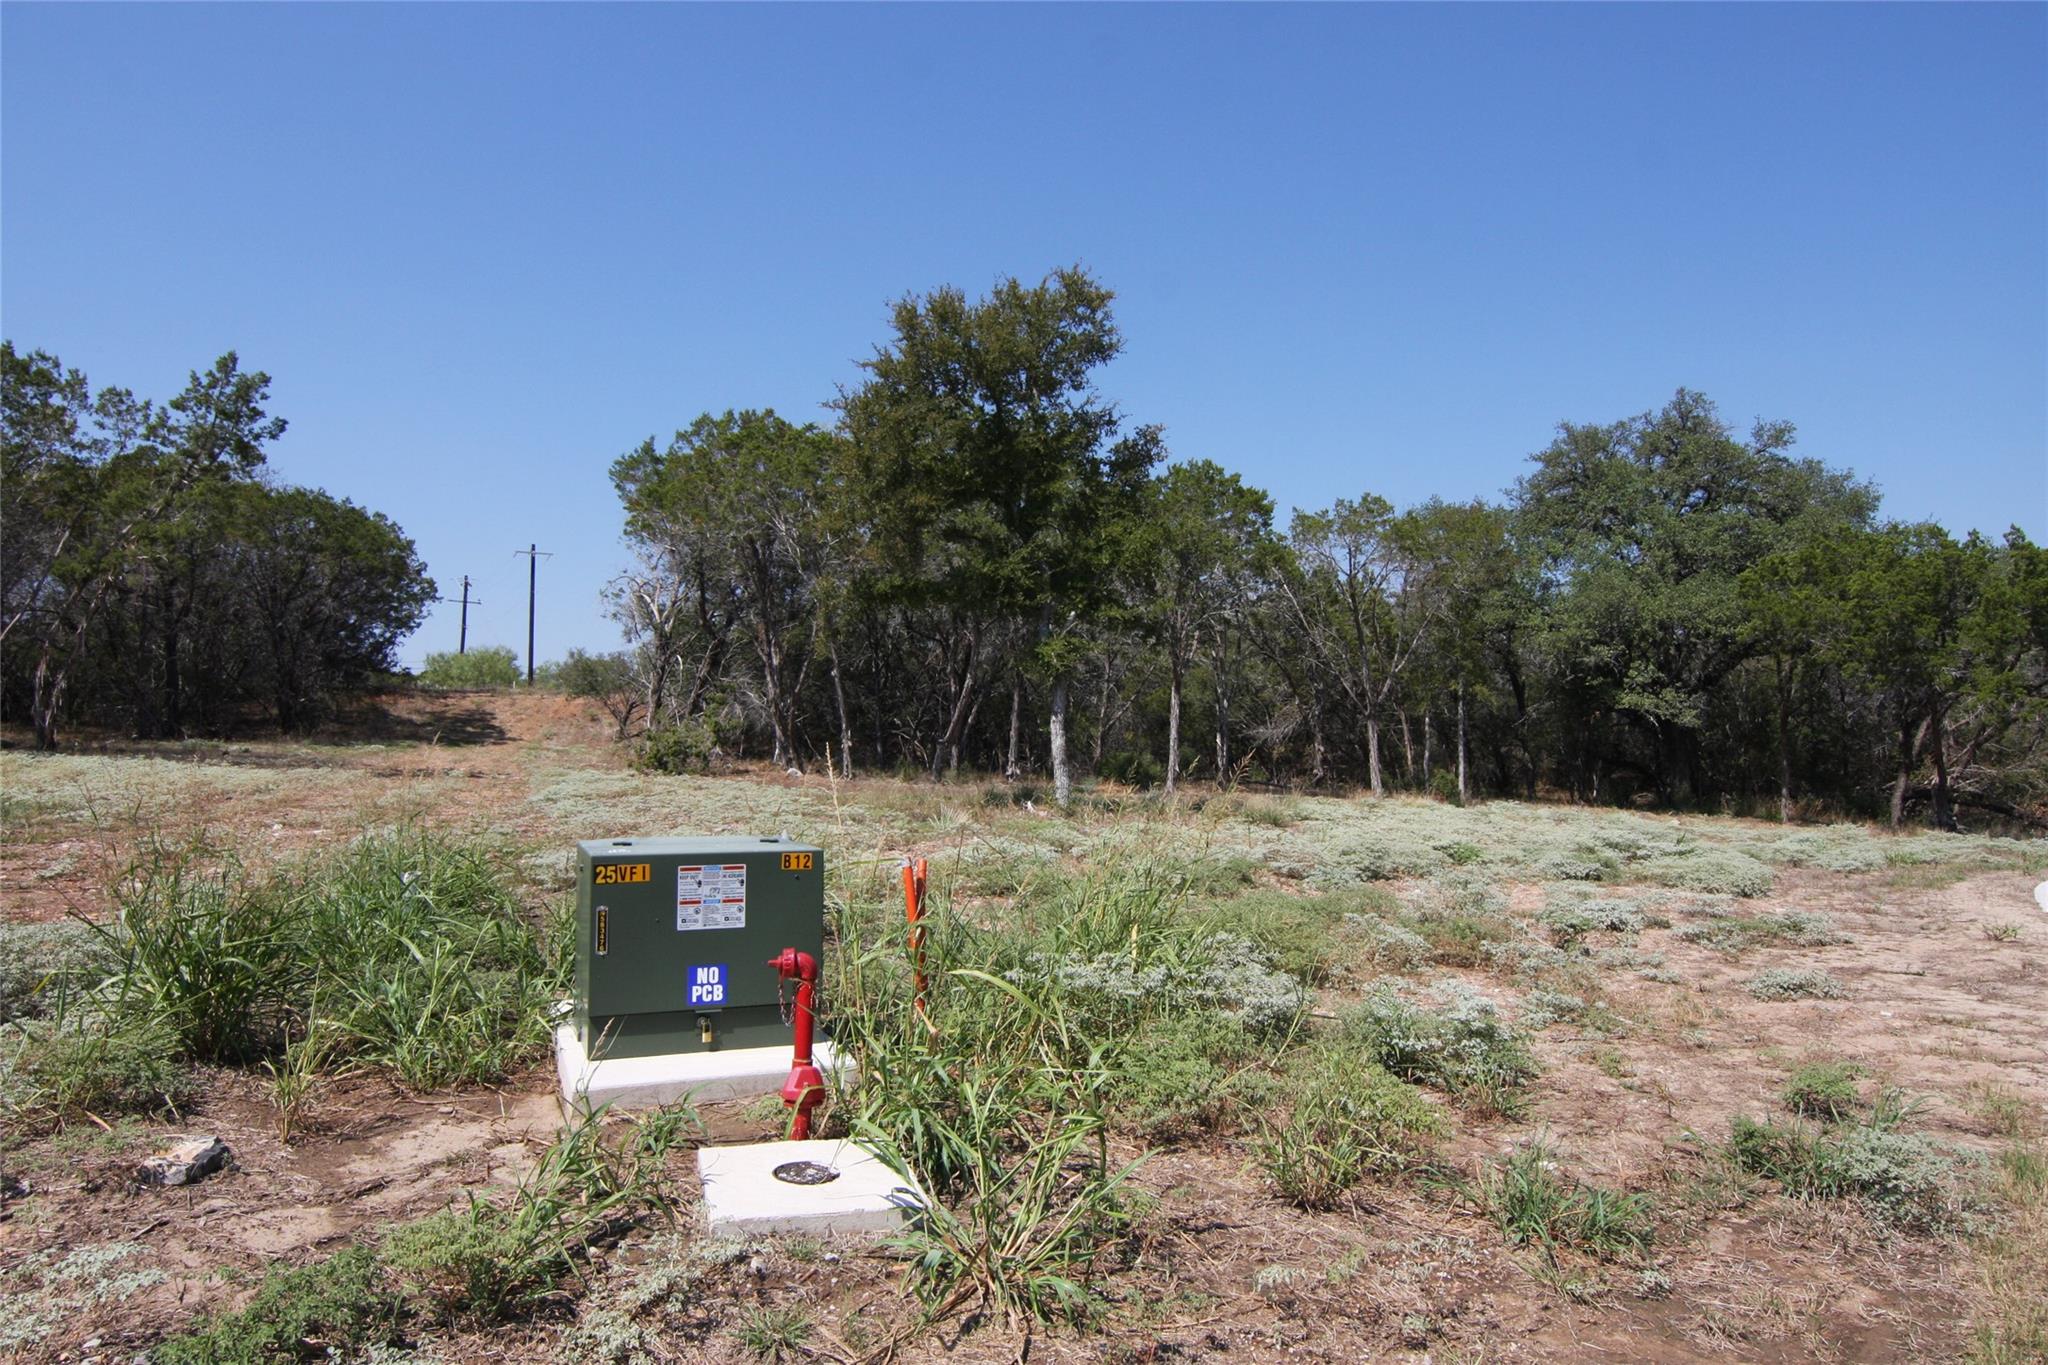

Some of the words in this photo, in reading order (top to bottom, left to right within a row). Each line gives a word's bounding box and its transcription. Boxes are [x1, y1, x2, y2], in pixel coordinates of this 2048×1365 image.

[783, 854, 810, 869] B12
[697, 966, 719, 984] NO
[692, 984, 723, 1002] PCB
